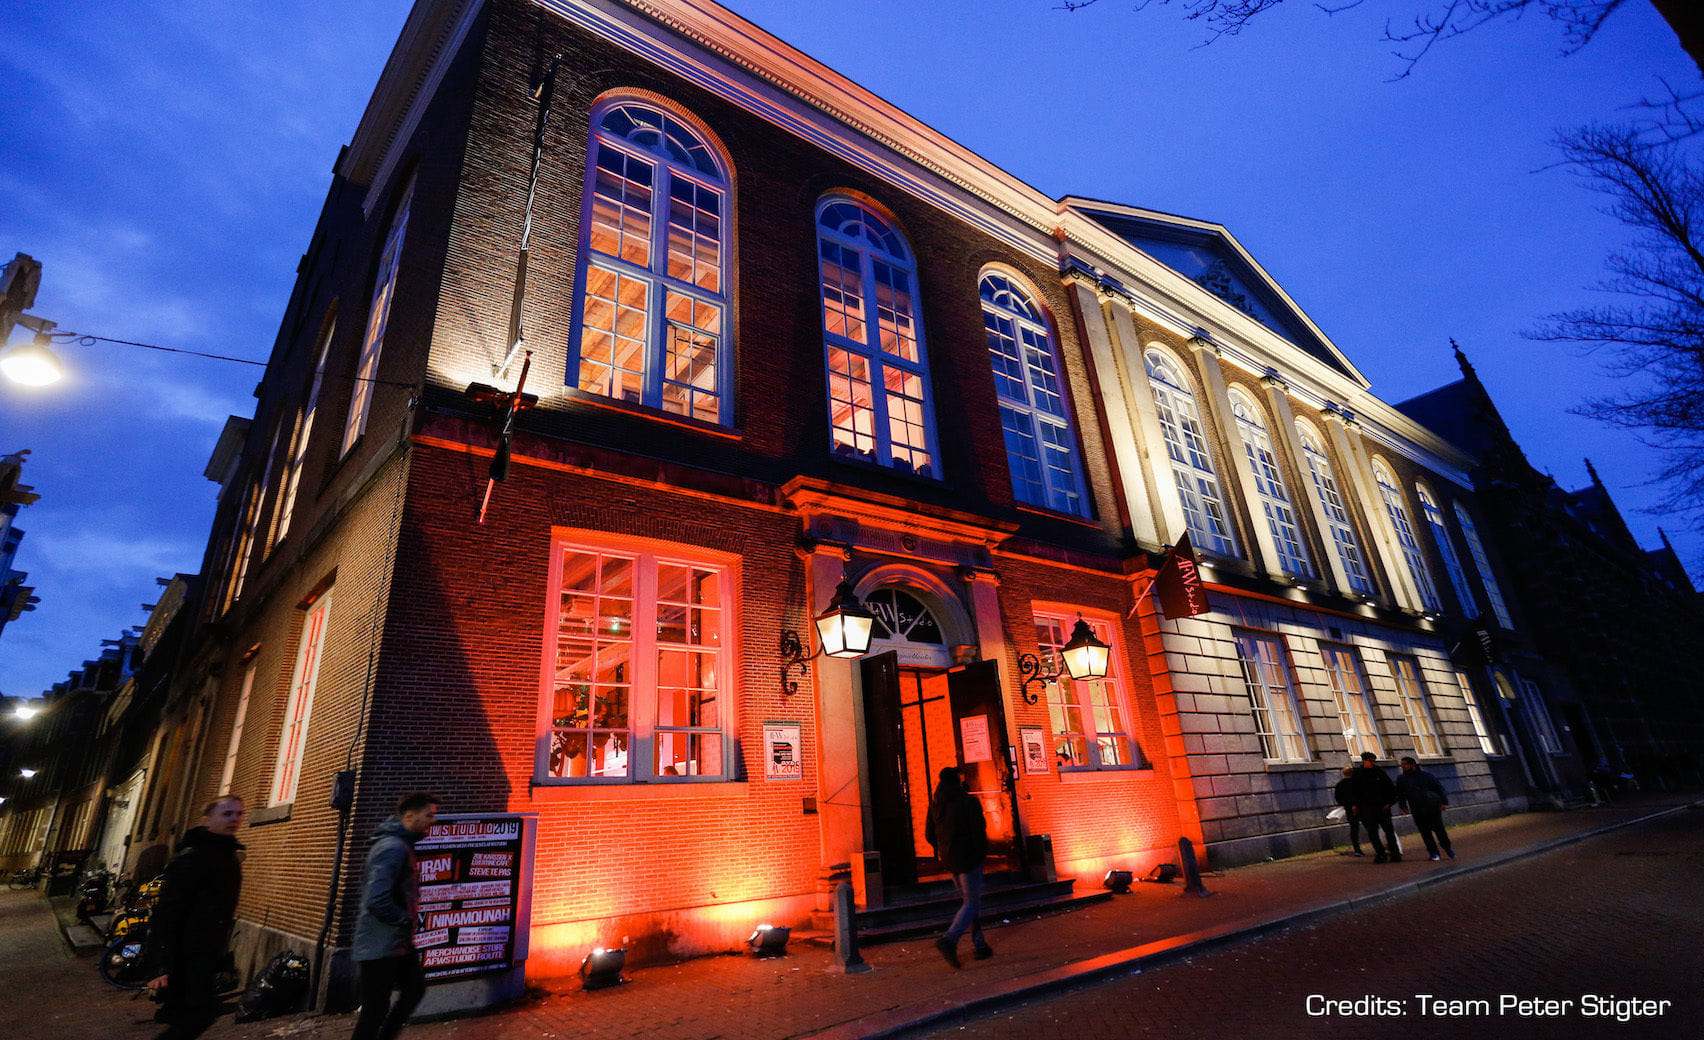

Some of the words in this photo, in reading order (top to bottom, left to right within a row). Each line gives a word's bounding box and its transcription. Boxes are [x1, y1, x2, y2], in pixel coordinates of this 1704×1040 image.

[432, 908, 511, 928] NINAMOUNAH
[426, 945, 482, 957] MERCHANDISE
[482, 943, 505, 953] STORE
[424, 954, 476, 966] AFWSTUDIO
[476, 951, 503, 961] ROUTE
